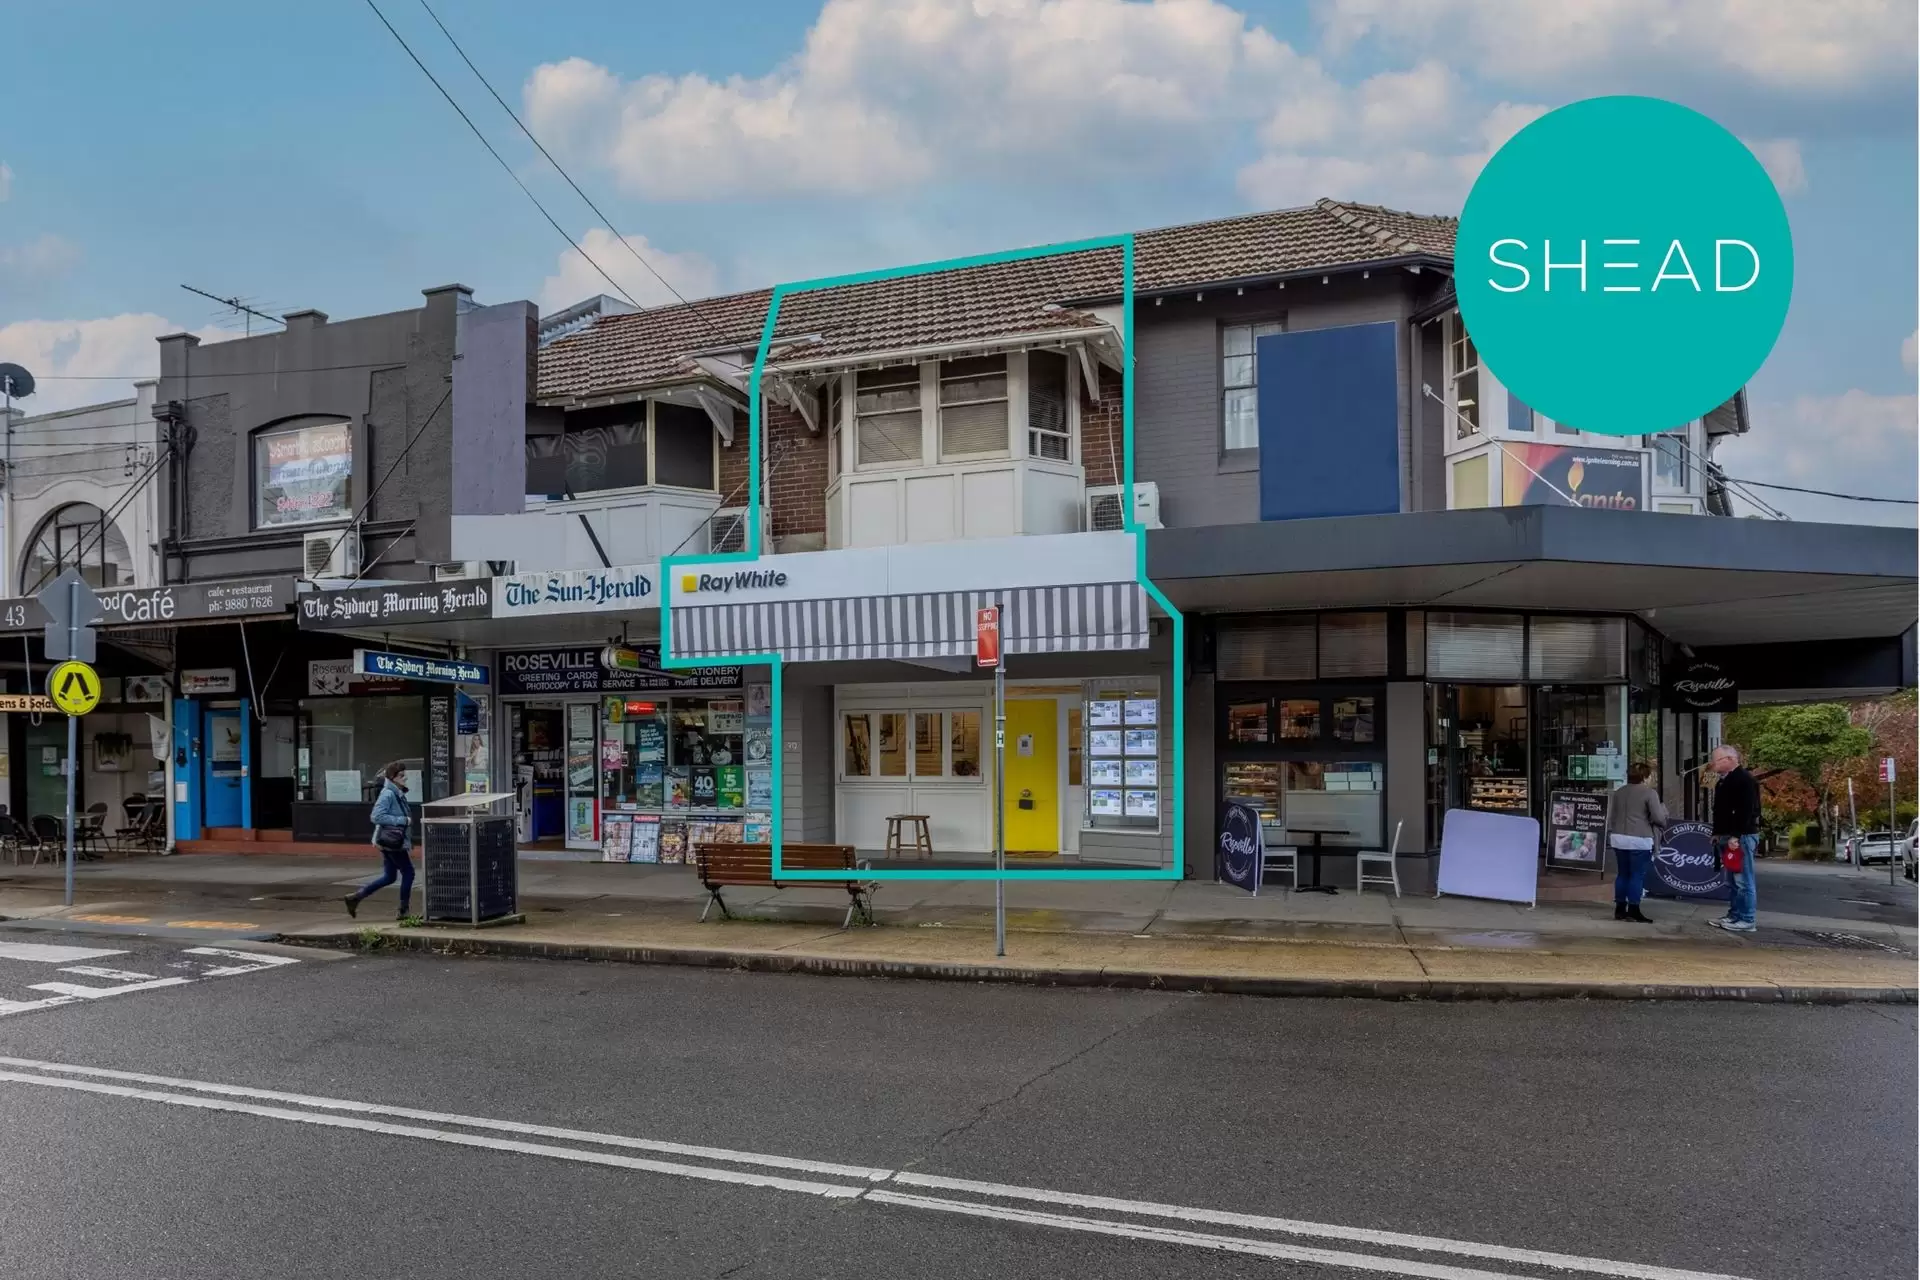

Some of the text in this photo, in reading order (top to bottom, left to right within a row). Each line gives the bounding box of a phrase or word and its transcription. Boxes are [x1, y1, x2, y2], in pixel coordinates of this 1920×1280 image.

[208, 584, 273, 597] cafe restaurant
[505, 574, 652, 607] The Sun-Herald
[121, 588, 175, 621] Café
[225, 598, 247, 610] 9880
[250, 596, 273, 609] 7626
[304, 585, 488, 620] The Sydney Morning Herald
[5, 605, 25, 626] 43
[983, 611, 992, 621] NO
[376, 655, 394, 673] The
[395, 657, 424, 677] Sydney
[426, 662, 456, 680] Morning
[457, 666, 481, 682] Herald
[505, 652, 595, 671] ROSEVILLE
[518, 673, 561, 682] GREETING
[567, 671, 598, 681] CARDS
[691, 667, 741, 676] ATIONERY
[526, 681, 569, 690] PHOTOCOPY
[582, 680, 598, 689] FAX
[602, 679, 635, 688] SERVICE
[701, 677, 739, 686] DELIVERY
[1673, 677, 1736, 692] Roseville
[1672, 823, 1696, 835] daily
[1220, 831, 1255, 855] Roseville
